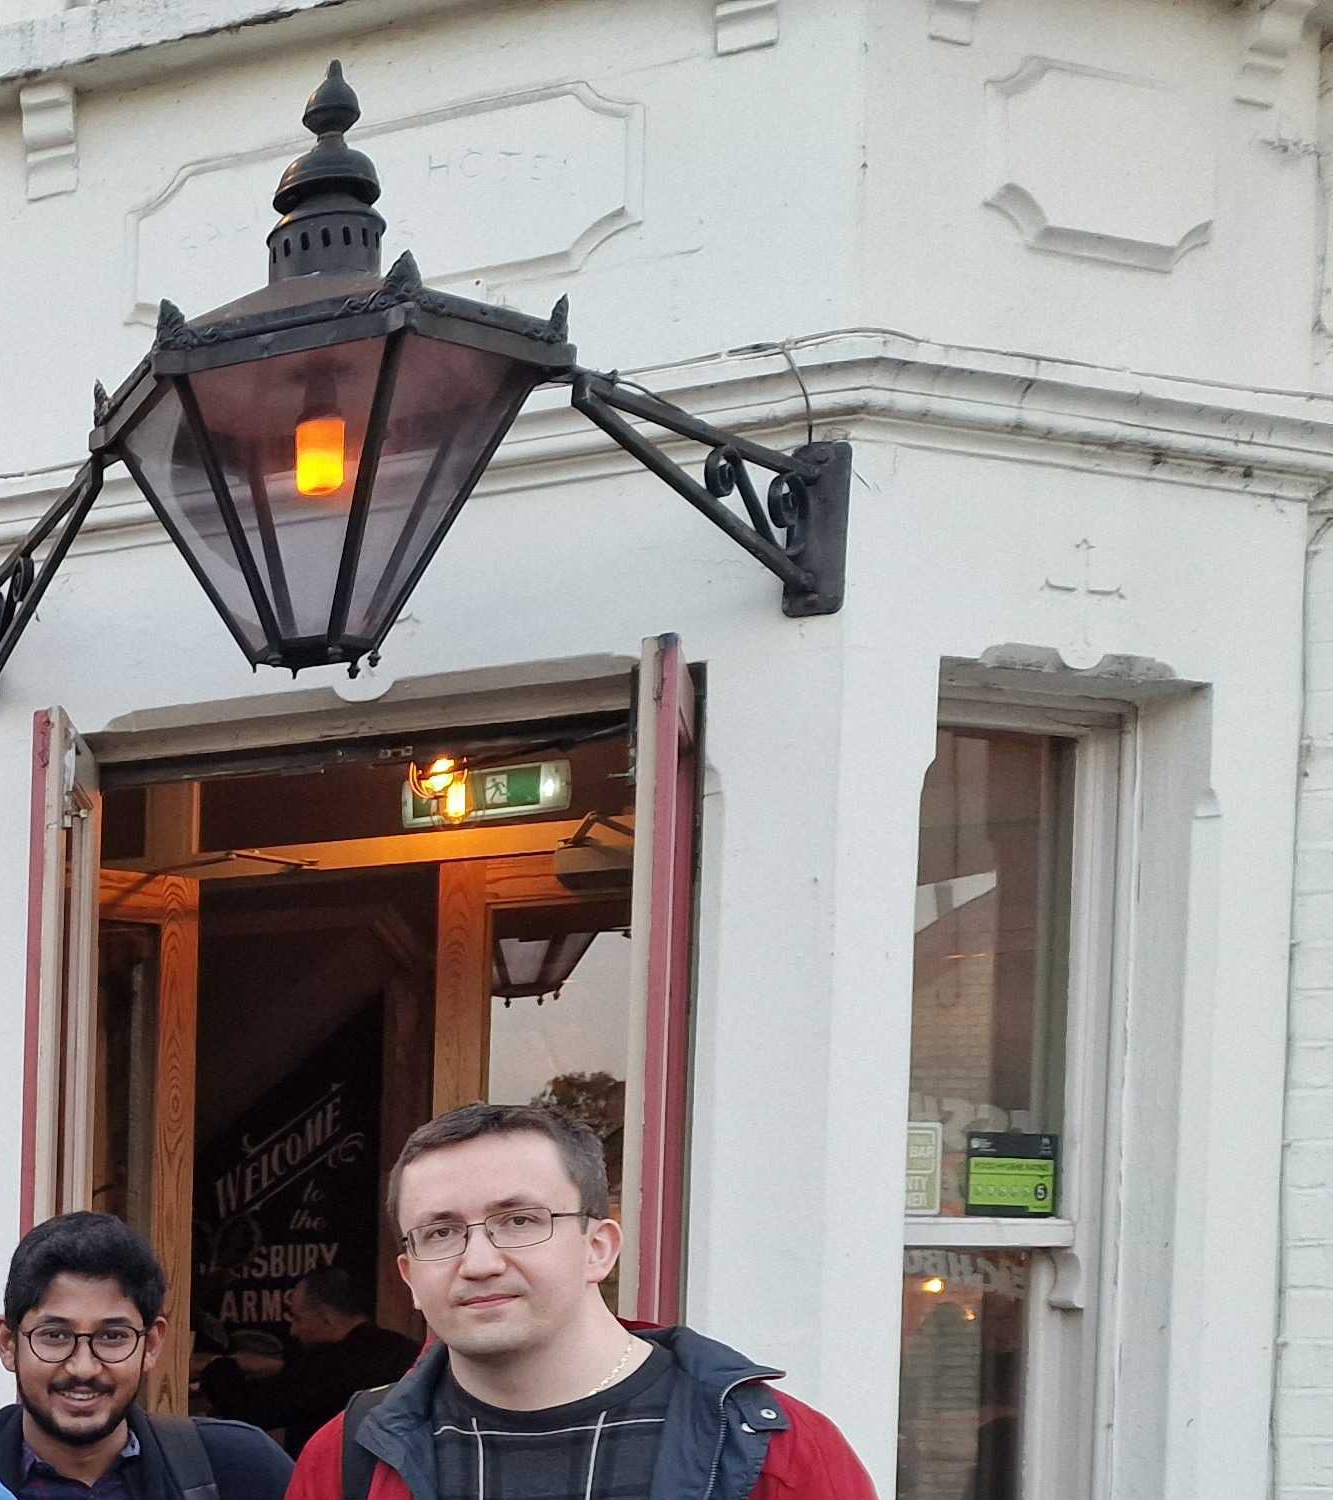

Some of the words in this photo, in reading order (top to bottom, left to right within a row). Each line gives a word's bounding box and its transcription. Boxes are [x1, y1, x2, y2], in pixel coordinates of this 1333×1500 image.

[213, 1096, 342, 1219] WELCOME
[302, 1178, 325, 1203] to
[290, 1209, 325, 1231] the
[219, 1289, 296, 1324] ARMS
